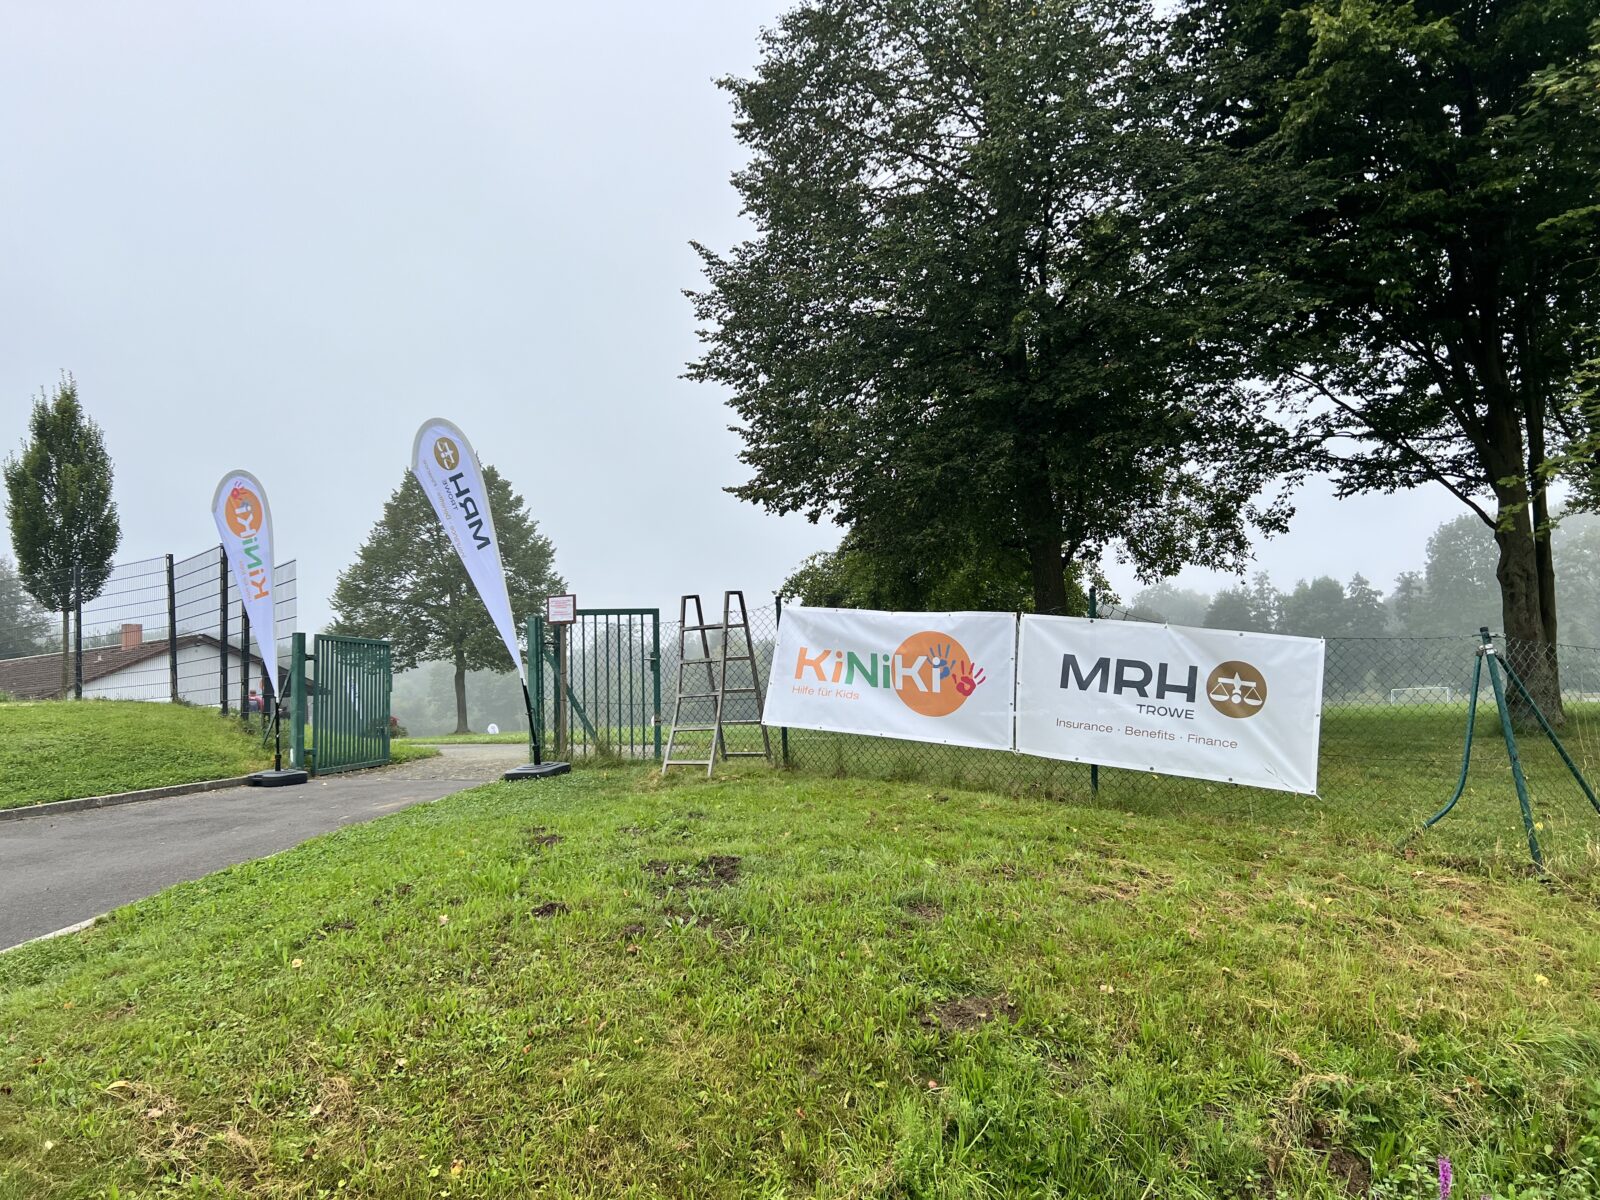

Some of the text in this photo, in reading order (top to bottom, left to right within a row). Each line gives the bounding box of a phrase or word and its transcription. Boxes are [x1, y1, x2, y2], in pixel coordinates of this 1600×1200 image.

[794, 646, 942, 694] KiNiKi
[1059, 653, 1199, 703] MRH
[791, 685, 860, 700] Hilfe für Kids
[1136, 703, 1195, 720] TROWE
[1055, 717, 1239, 750] Insurance Benefits Finance
